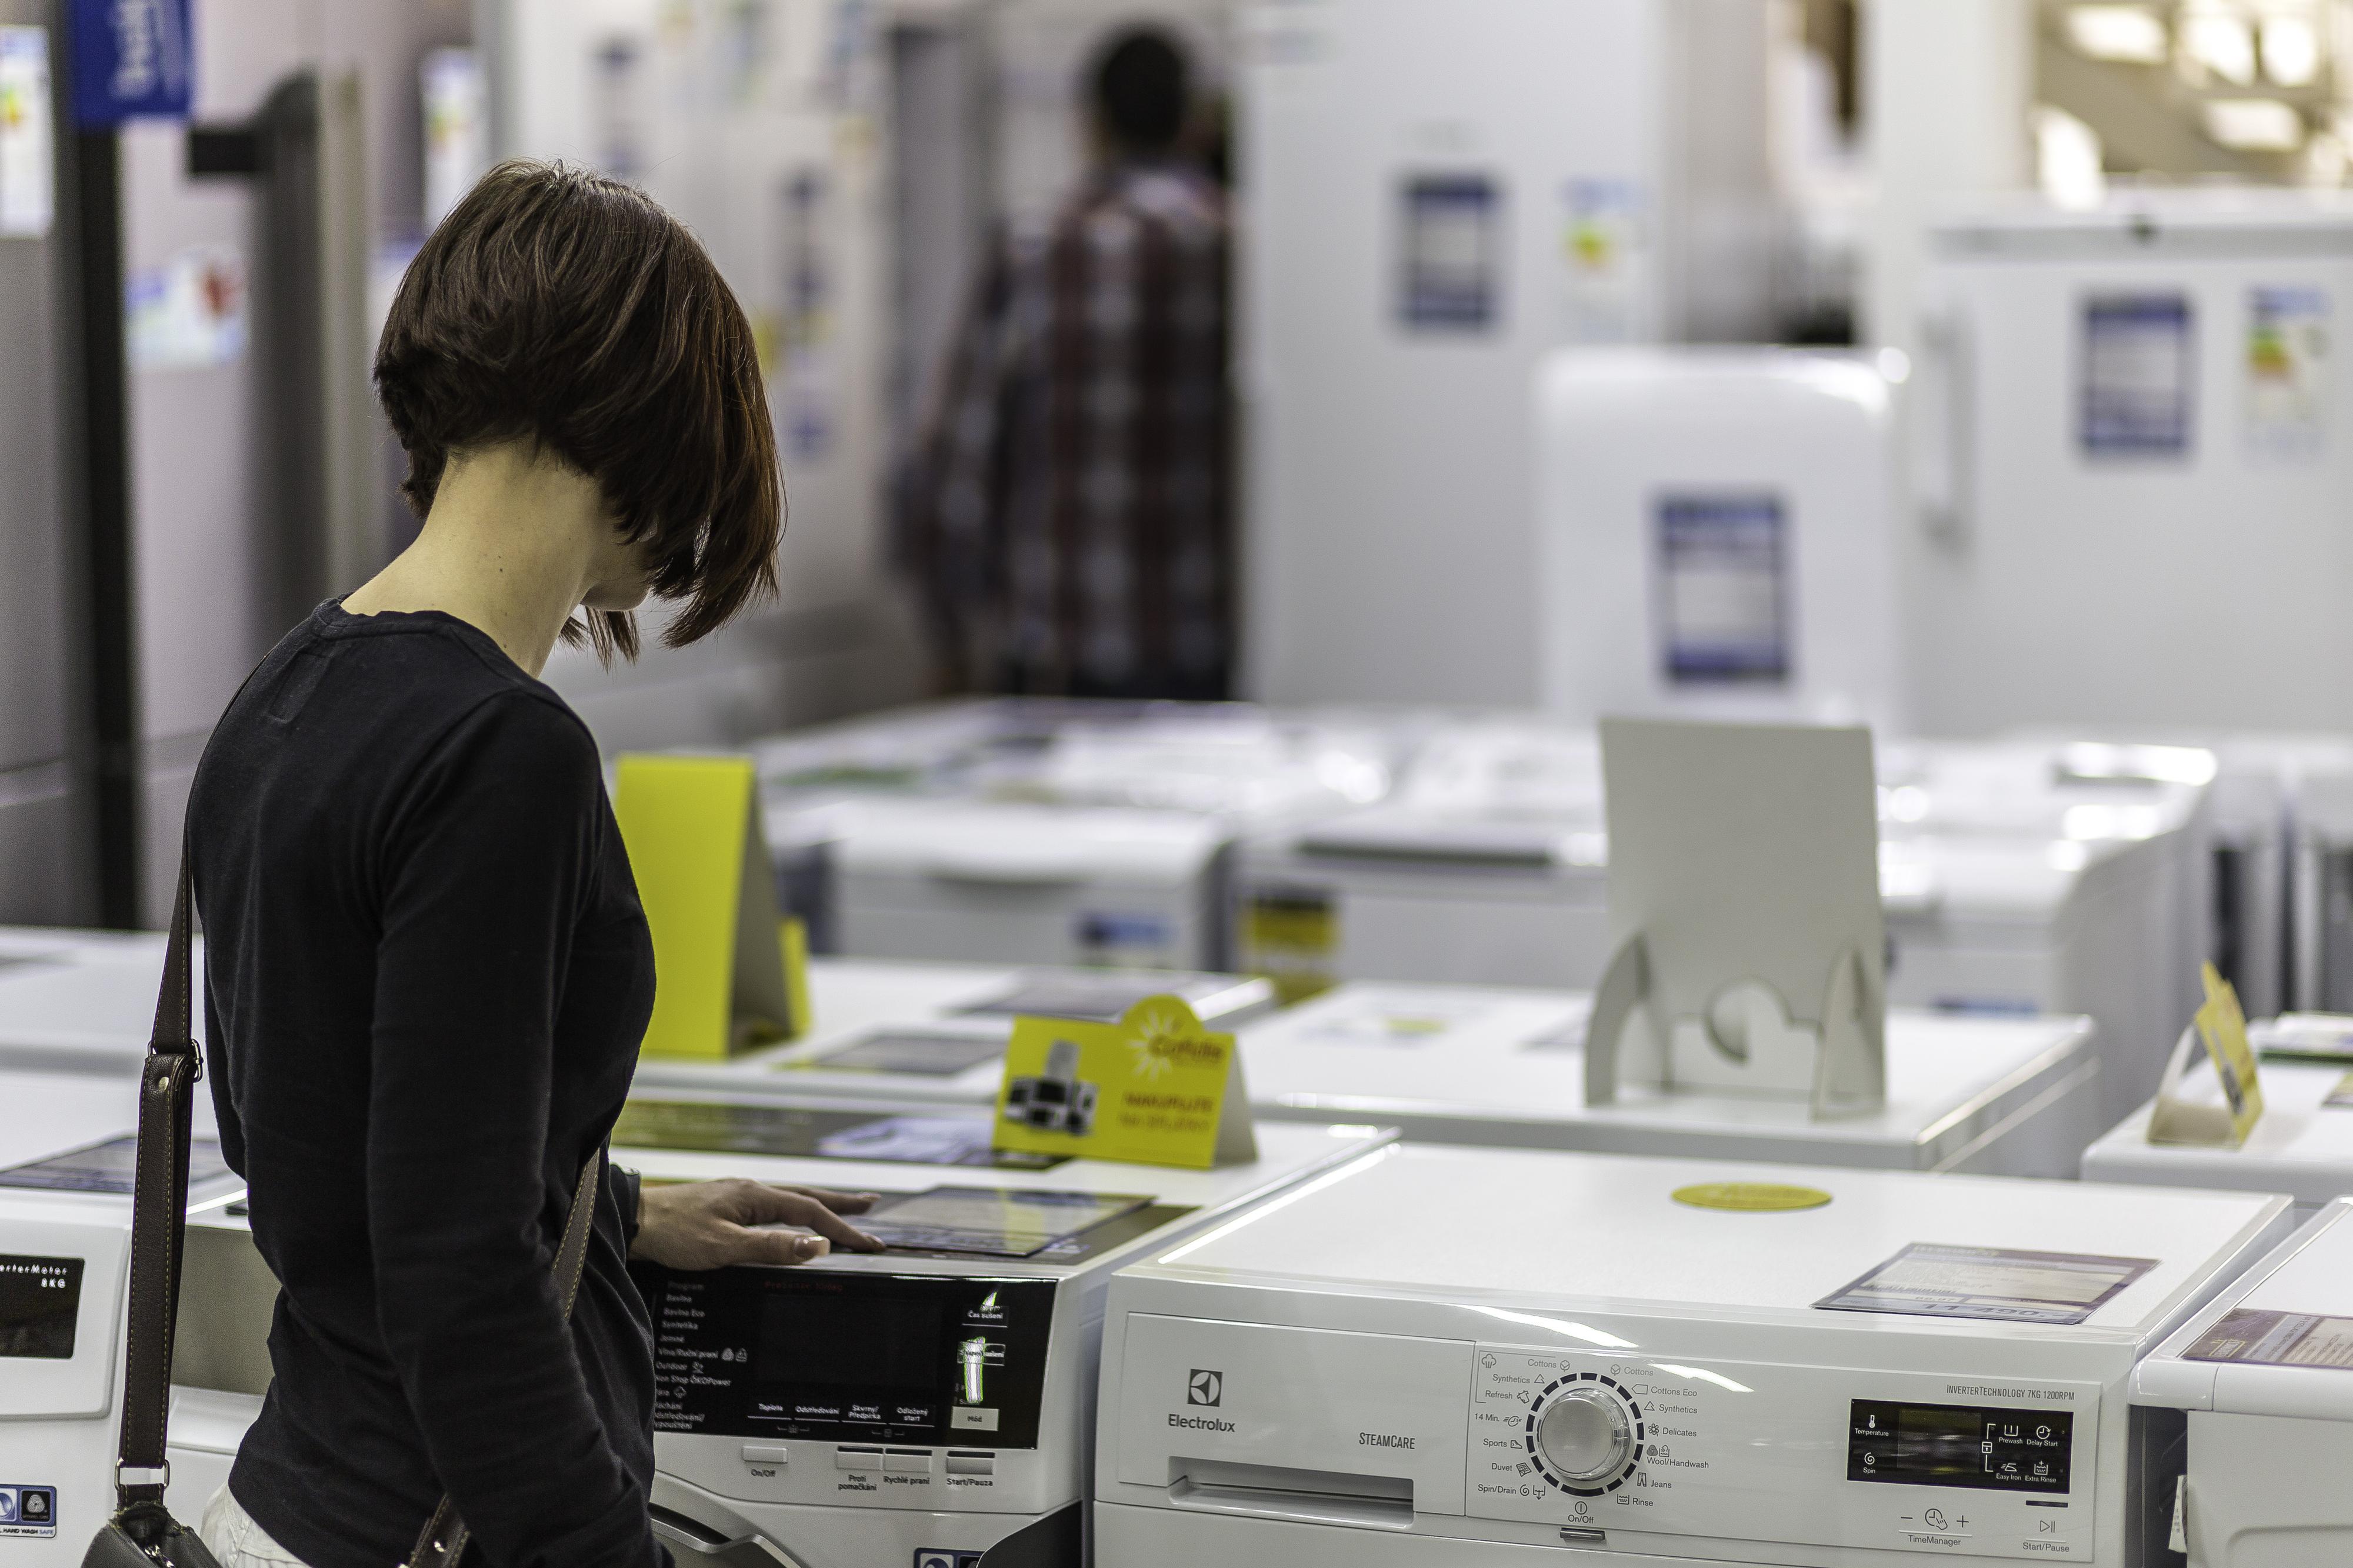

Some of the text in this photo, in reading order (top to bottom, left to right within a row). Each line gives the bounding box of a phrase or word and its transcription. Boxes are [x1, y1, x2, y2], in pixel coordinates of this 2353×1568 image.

[1528, 1359, 1557, 1369] Cottons
[1624, 1367, 1654, 1376] Cottons
[1492, 1374, 1530, 1384] Synthetics
[1485, 1390, 1513, 1399] Refresh
[1651, 1386, 1697, 1397] Cottons Eco
[2028, 1389, 2041, 1399] 7KG
[2044, 1390, 2075, 1400] 1200RPM
[1658, 1404, 1698, 1414] Synthetics
[1485, 1414, 1500, 1422] Min.
[1168, 1414, 1235, 1433] Electrolux
[1662, 1427, 1697, 1437] Delicates
[1855, 1428, 1889, 1437] Temperature
[1483, 1439, 1507, 1449] Sports
[2027, 1439, 2041, 1447] Delay
[1491, 1463, 1512, 1472] Duvet
[1647, 1457, 1709, 1469] Wool/Handwash
[1863, 1467, 1876, 1475] Spin
[946, 1478, 993, 1487] Start/Pauza
[1651, 1480, 1672, 1489] Jeans
[1478, 1484, 1517, 1495] Spin/Drain
[1632, 1498, 1654, 1507] Rinse
[1568, 1514, 1594, 1524] On/Off
[1908, 1535, 1961, 1547] TimeManager
[2022, 1542, 2070, 1553] Start/Pause
